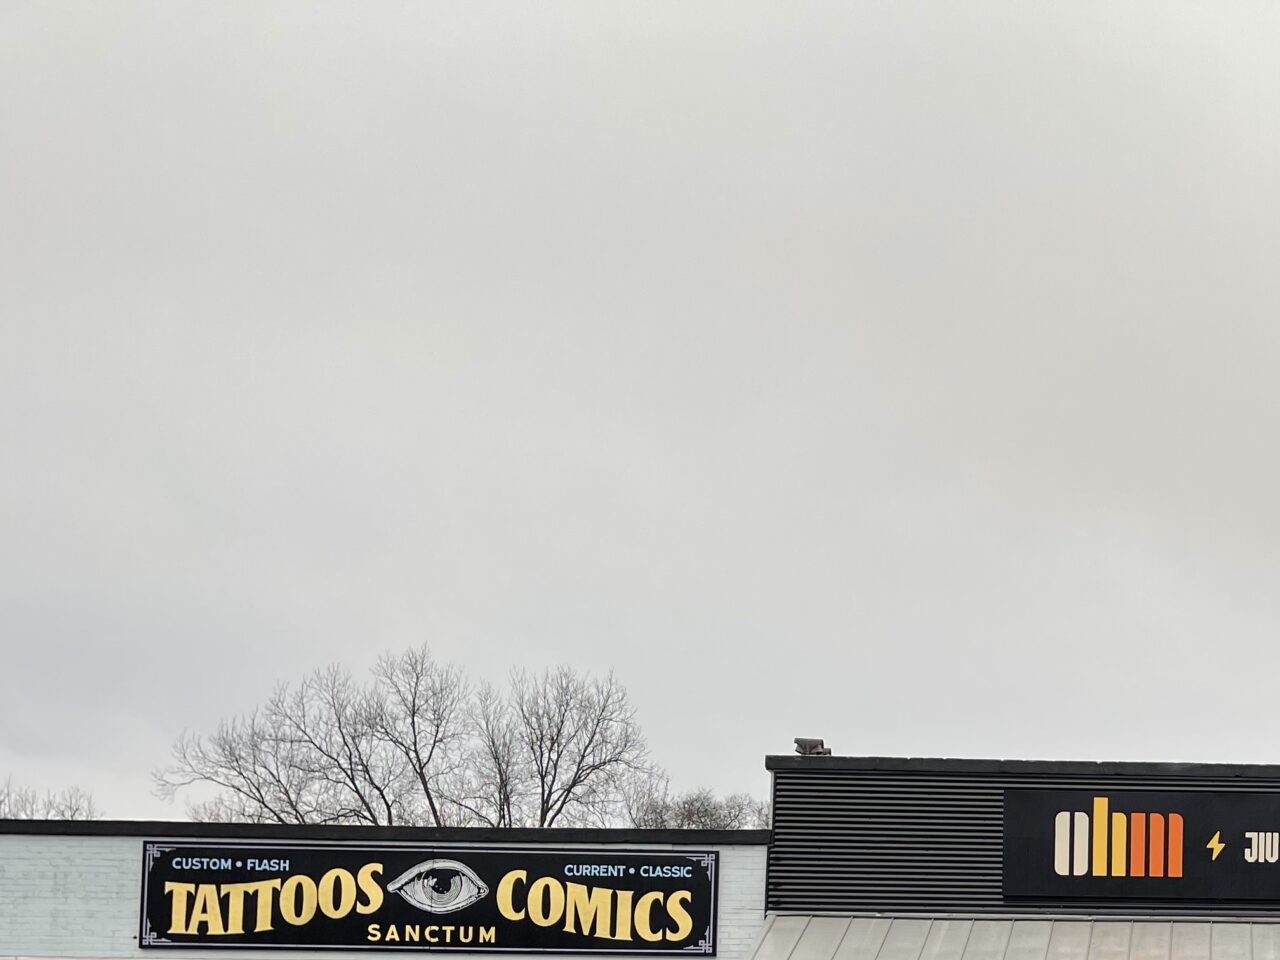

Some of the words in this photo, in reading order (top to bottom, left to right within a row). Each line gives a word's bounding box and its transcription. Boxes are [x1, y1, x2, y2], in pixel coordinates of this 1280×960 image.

[1054, 796, 1184, 878] ohm
[1244, 831, 1279, 864] JIU
[171, 857, 232, 871] CUSTOM
[246, 858, 290, 871] FLASH
[564, 864, 626, 879] CURRENT
[640, 865, 693, 879] CLASSIC
[164, 862, 384, 936] TATTOOS
[496, 869, 694, 943] COMICS
[366, 923, 497, 944] SANCTUM
